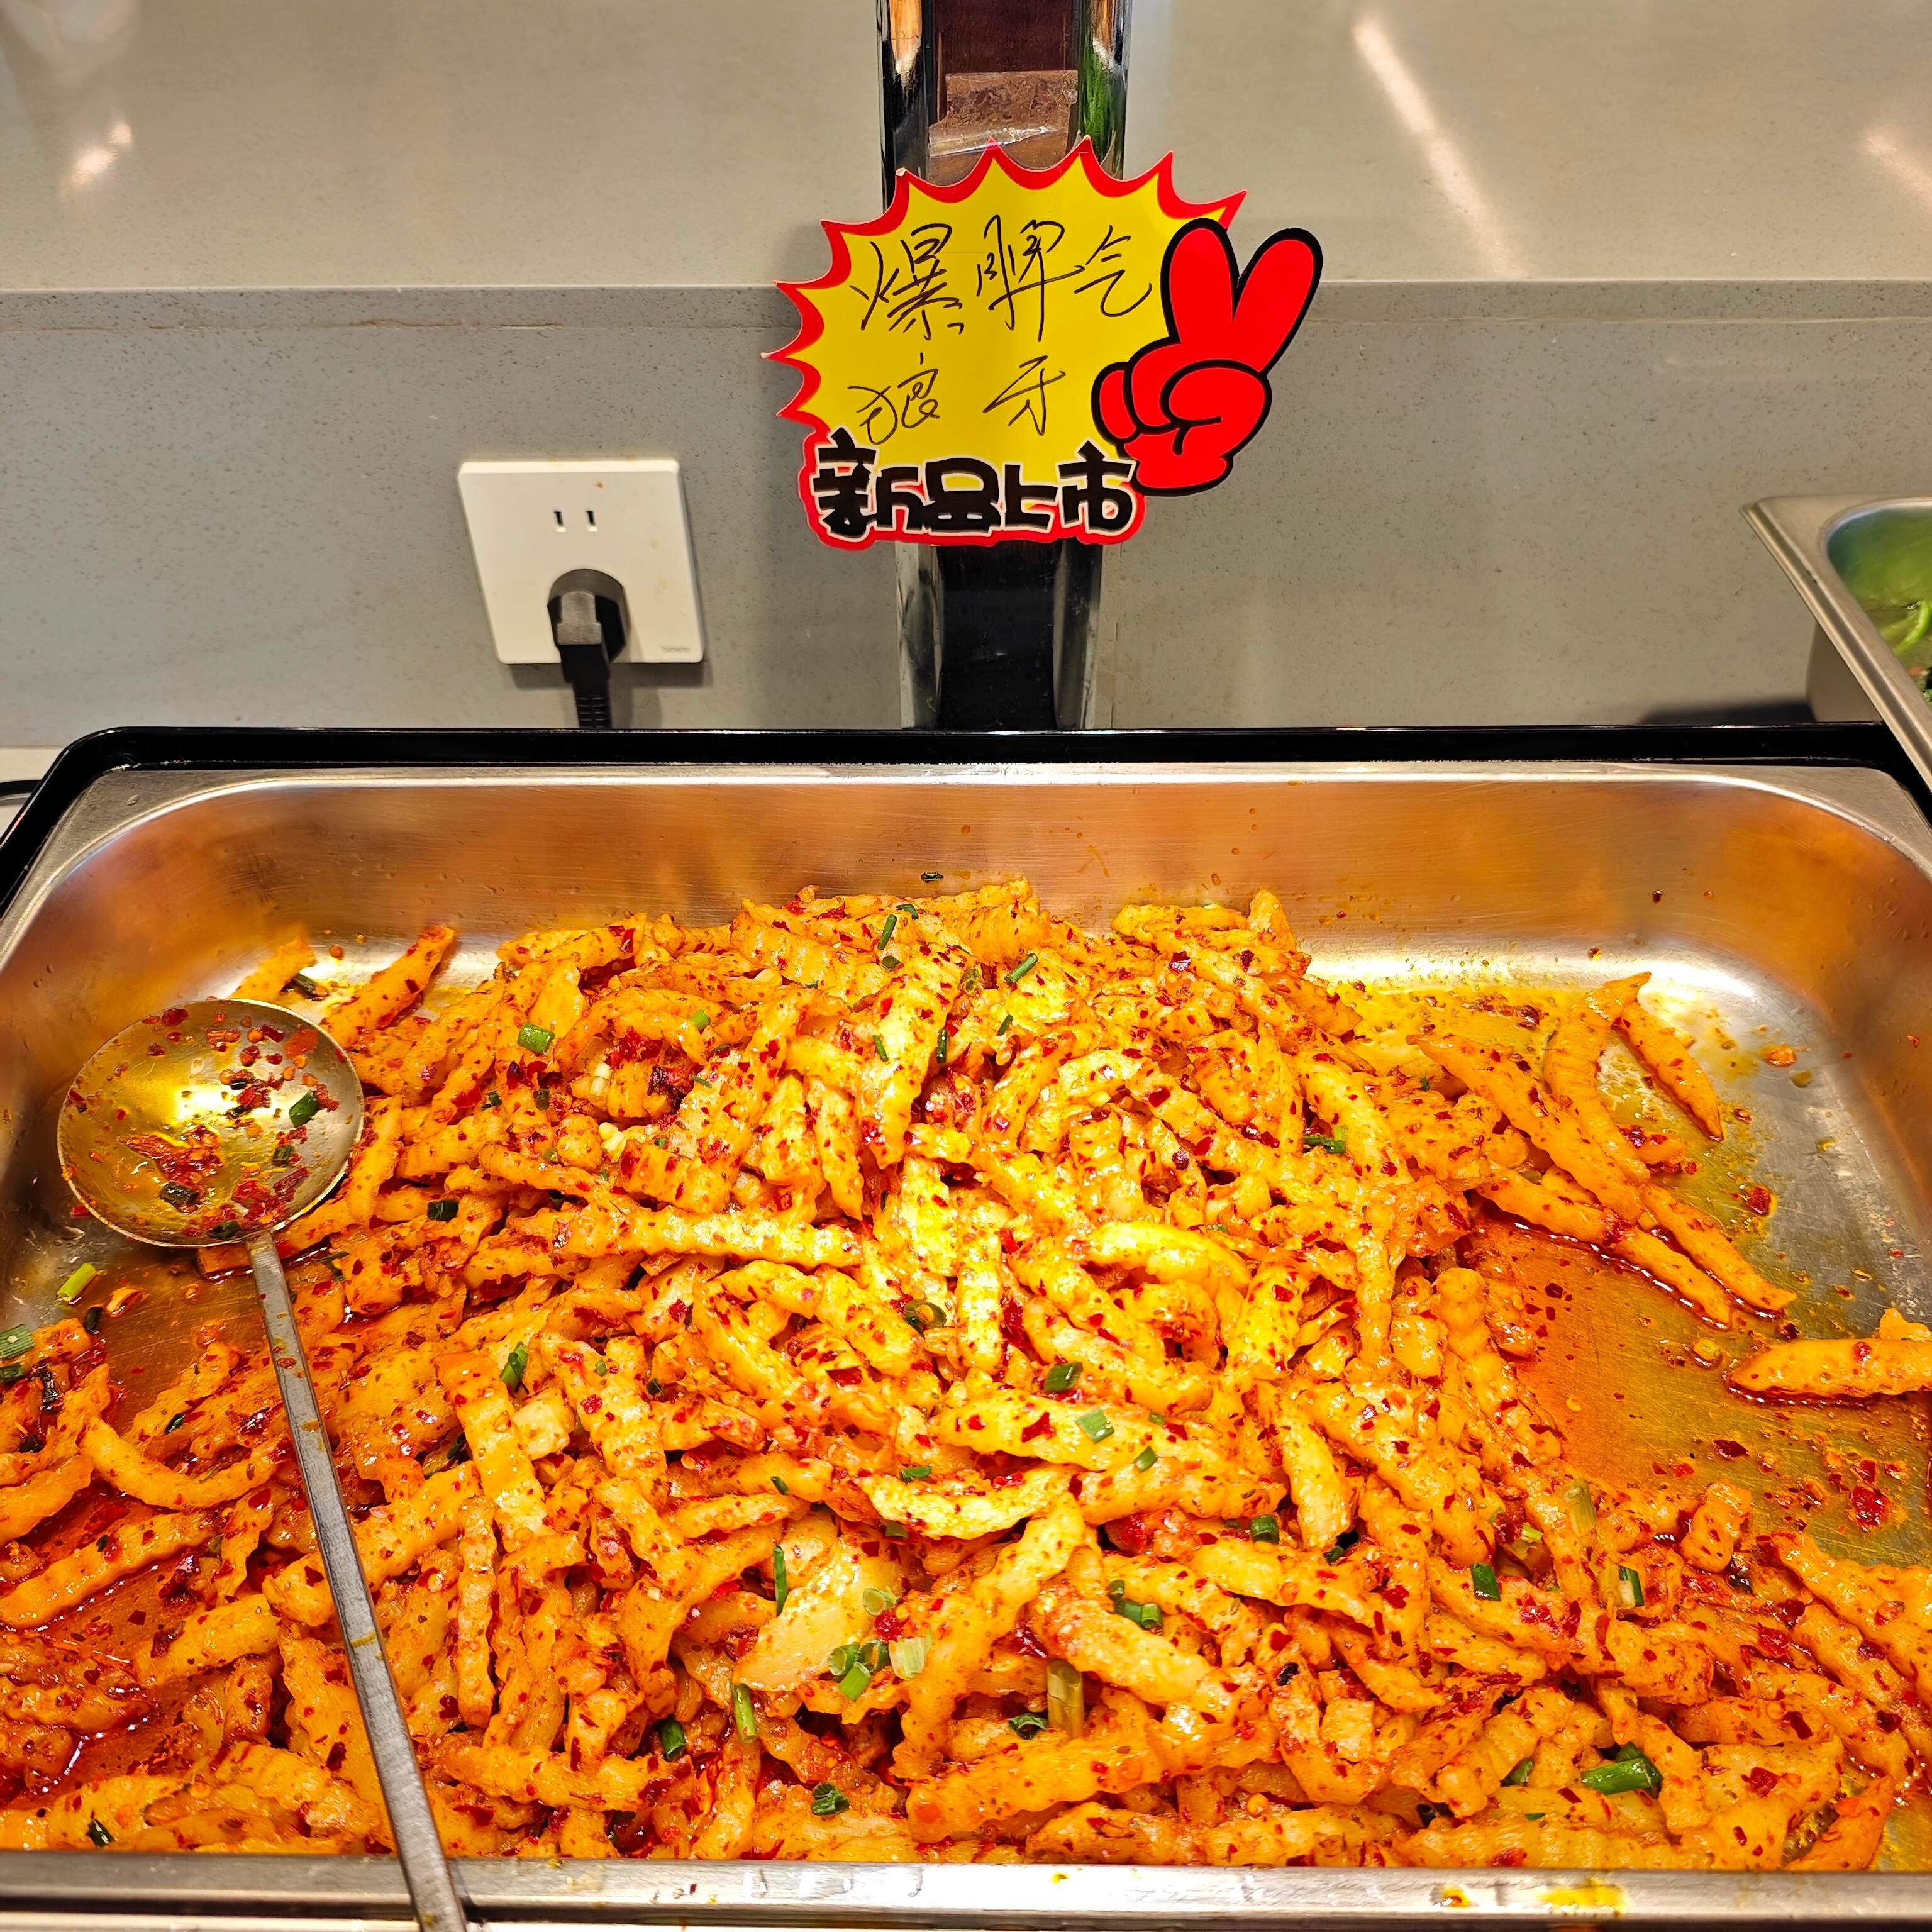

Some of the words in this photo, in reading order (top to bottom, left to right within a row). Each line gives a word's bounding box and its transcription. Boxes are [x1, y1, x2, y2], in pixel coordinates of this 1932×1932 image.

[849, 215, 1152, 342] 爆脾气
[813, 429, 1134, 537] 新品上市
